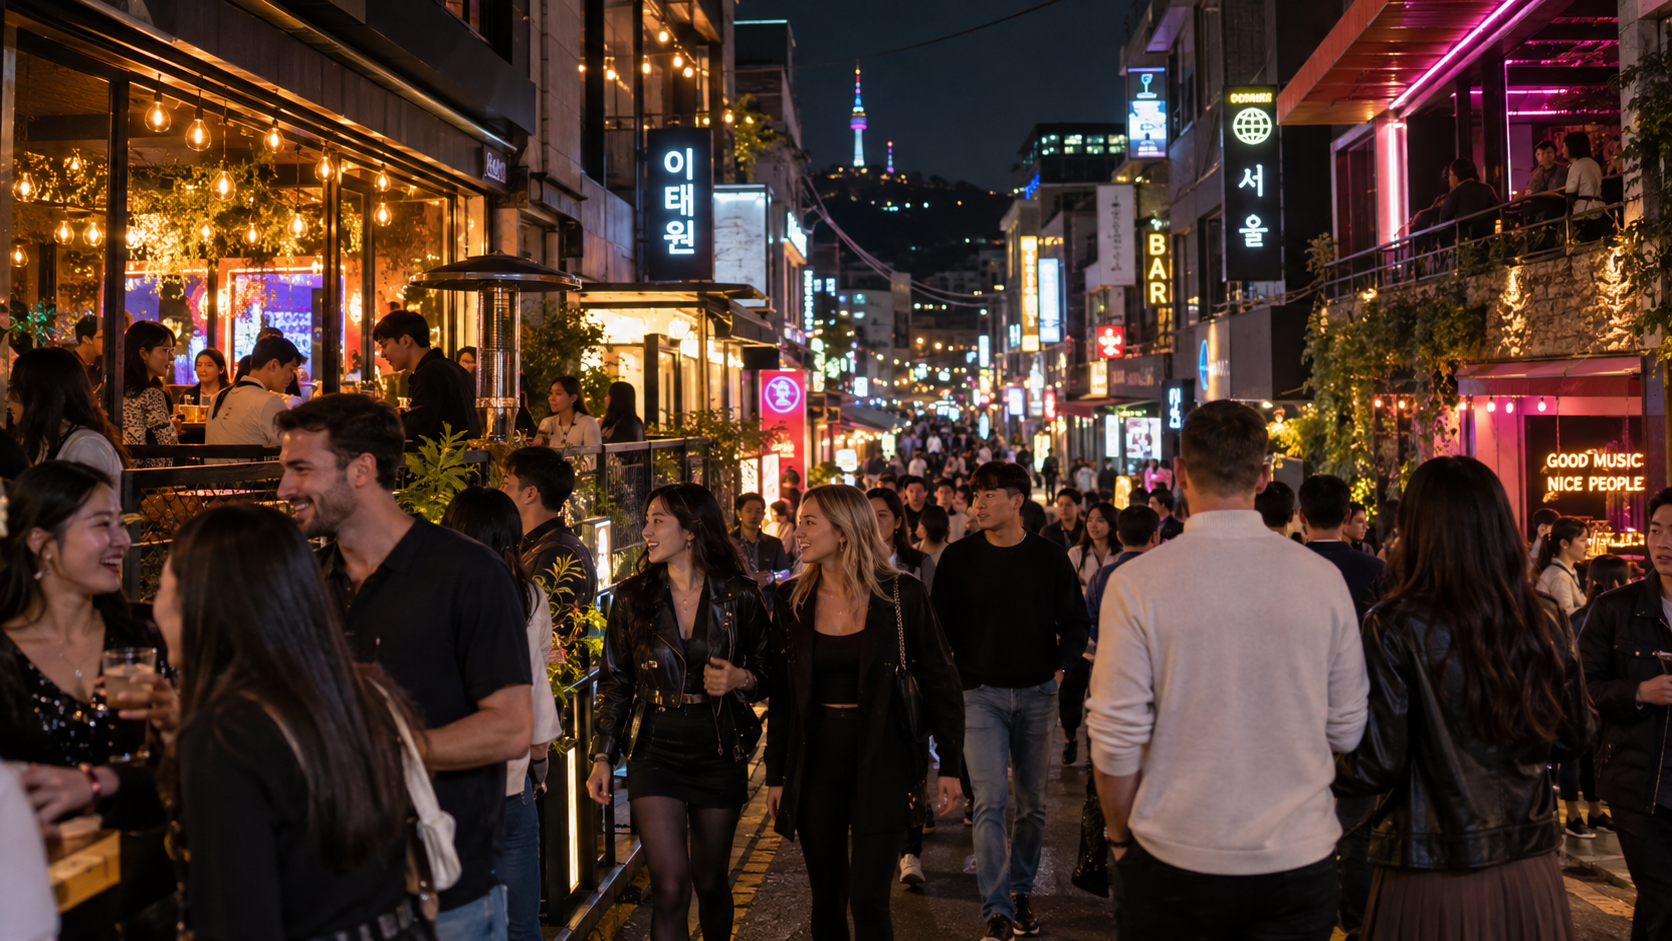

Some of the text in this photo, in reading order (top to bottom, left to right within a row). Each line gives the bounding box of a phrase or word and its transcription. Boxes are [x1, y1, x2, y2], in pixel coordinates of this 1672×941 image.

[663, 147, 695, 255] 이태원
[1238, 163, 1269, 248] 서울
[1148, 233, 1168, 304] BAR
[1546, 452, 1645, 468] GOOD MUSIC
[1547, 476, 1646, 492] NICE PEOPLE
